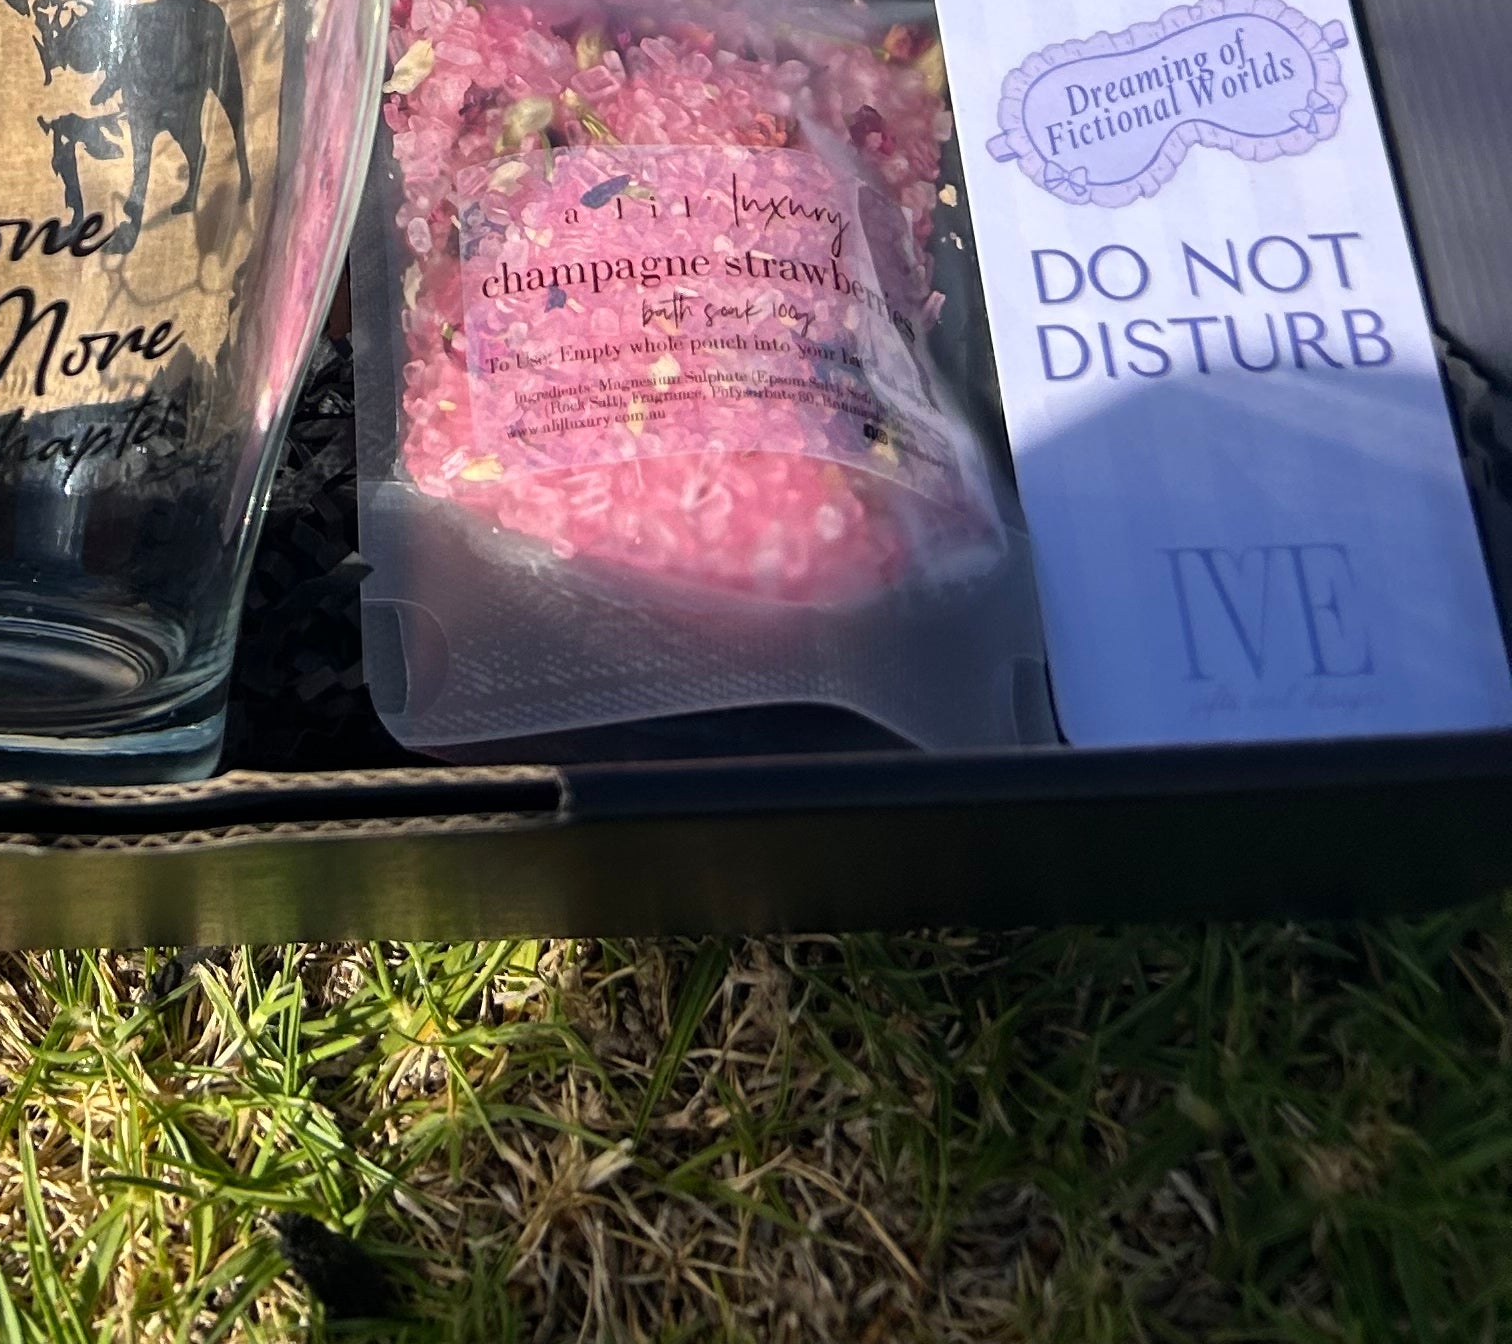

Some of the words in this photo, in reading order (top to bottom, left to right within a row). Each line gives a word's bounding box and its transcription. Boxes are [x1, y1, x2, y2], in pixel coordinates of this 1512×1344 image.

[1045, 83, 1182, 156] Fictional
[1187, 50, 1295, 108] Worlds
[1065, 51, 1215, 116] Dreaming
[1219, 27, 1247, 70] of
[481, 254, 711, 298] champagne
[1030, 242, 1152, 306] DO
[1181, 231, 1362, 299] NOT
[641, 292, 704, 329] bath
[1035, 309, 1395, 383] DISTURB
[486, 356, 511, 374] To
[560, 343, 621, 363] Empty
[629, 335, 683, 354] whole
[690, 333, 748, 354] pouch
[754, 334, 792, 353] into
[797, 343, 836, 360] your
